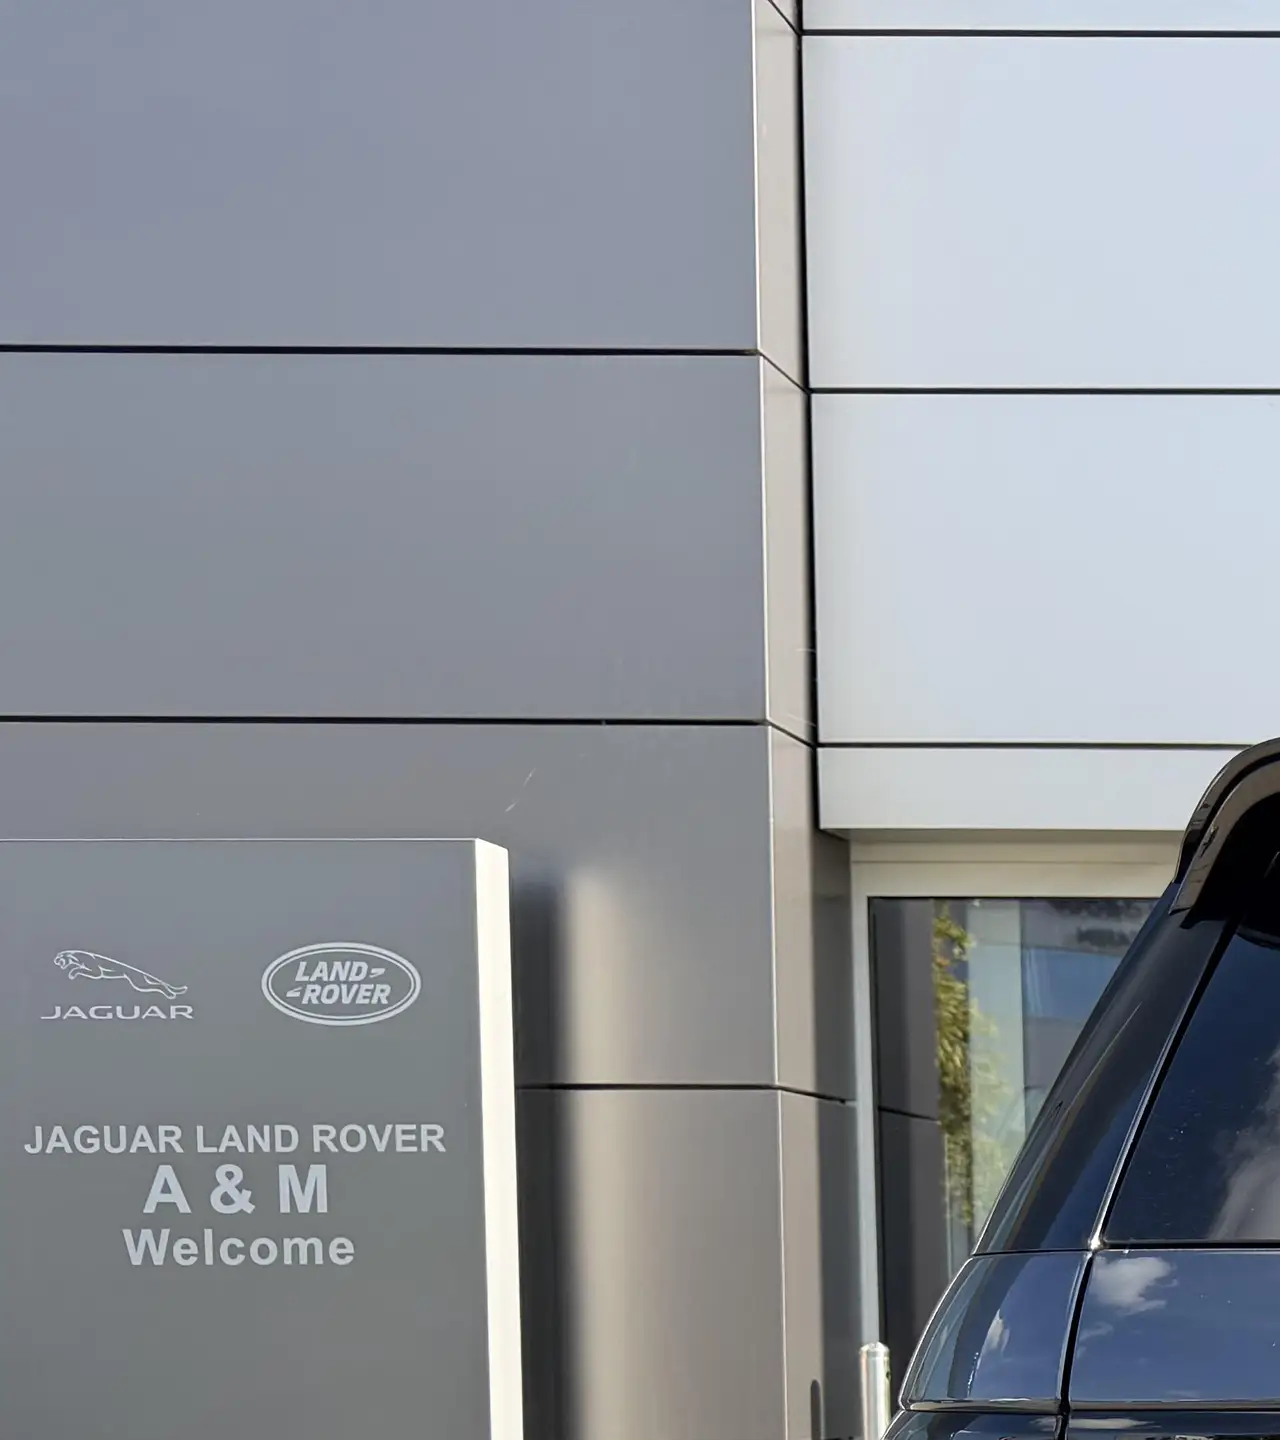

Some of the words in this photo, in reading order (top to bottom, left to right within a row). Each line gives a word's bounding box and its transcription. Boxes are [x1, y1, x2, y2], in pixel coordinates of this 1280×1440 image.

[295, 961, 368, 981] LAND
[301, 983, 391, 1005] ROVER
[40, 1005, 194, 1020] JAGUAR
[24, 1125, 184, 1155] JAGUAR
[196, 1125, 300, 1153] LAND
[312, 1124, 447, 1153] ROVER
[142, 1164, 192, 1214] A
[209, 1163, 256, 1215] &
[279, 1164, 328, 1213] M
[122, 1228, 355, 1267] Welcome
